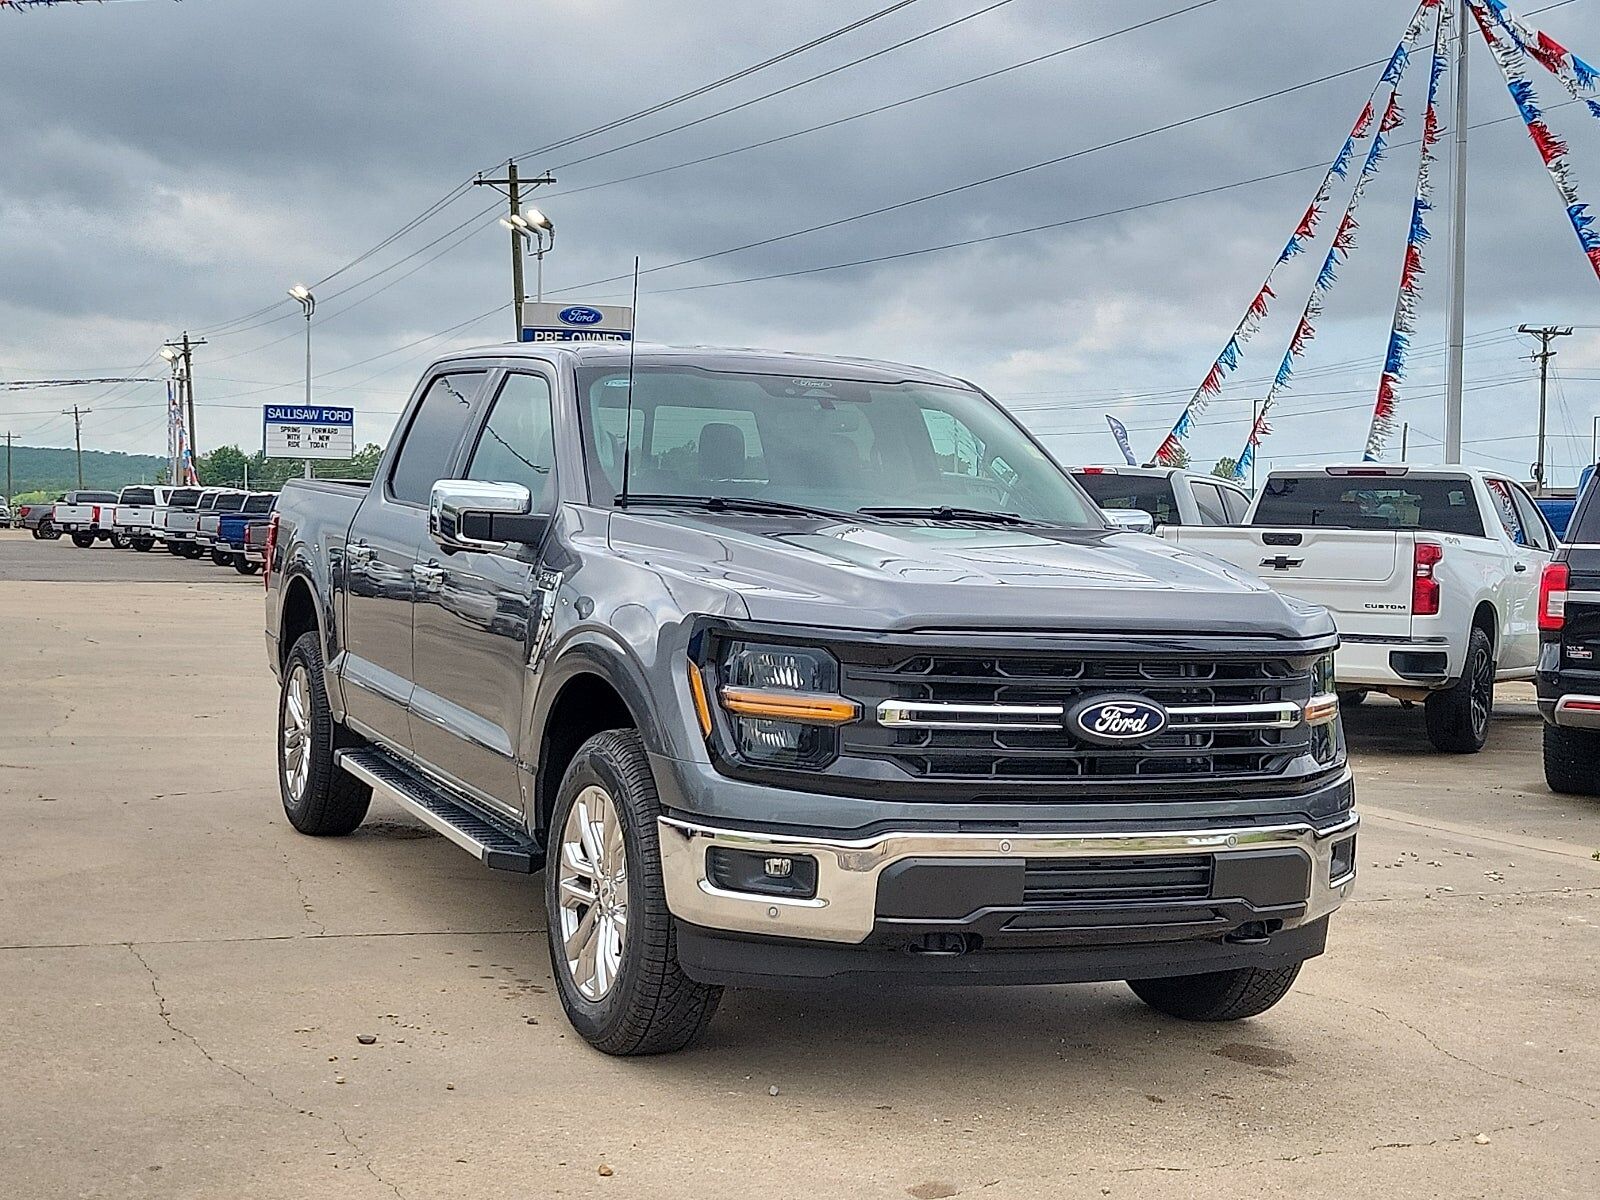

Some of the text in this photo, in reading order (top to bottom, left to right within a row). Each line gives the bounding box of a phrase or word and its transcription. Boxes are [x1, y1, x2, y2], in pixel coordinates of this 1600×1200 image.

[568, 309, 595, 322] Ford
[534, 331, 624, 342] PRE-OWNED
[267, 408, 351, 421] SALLISAW FORD
[312, 427, 338, 435] FORWARD
[1094, 705, 1150, 732] Ford
